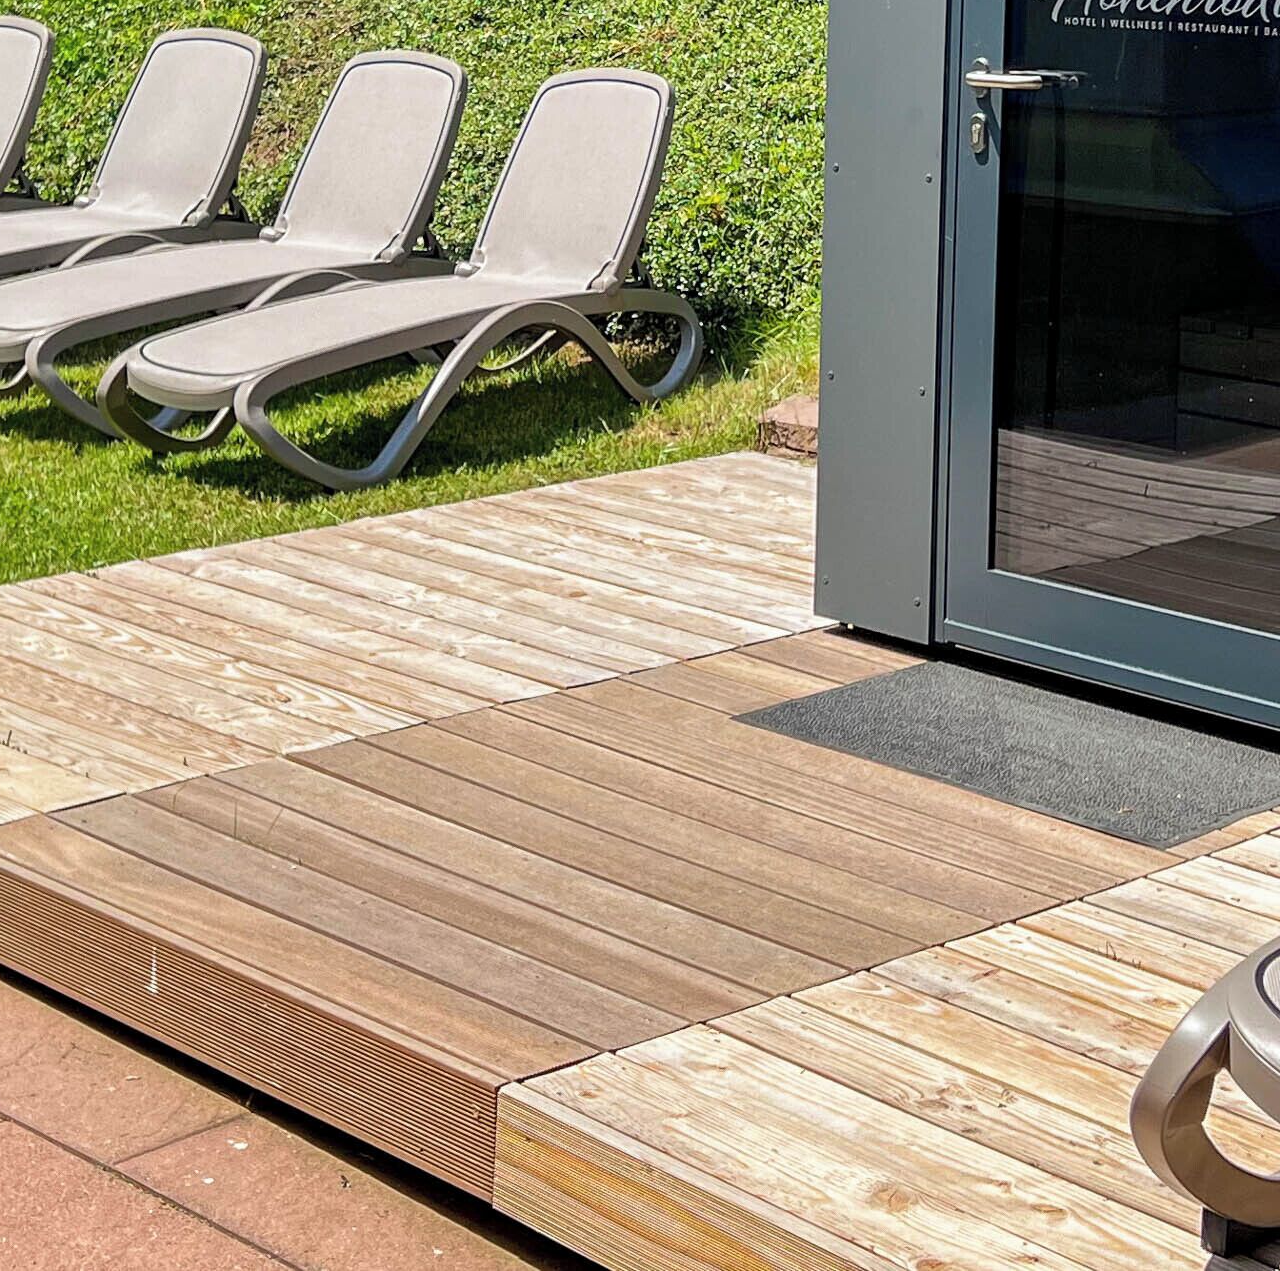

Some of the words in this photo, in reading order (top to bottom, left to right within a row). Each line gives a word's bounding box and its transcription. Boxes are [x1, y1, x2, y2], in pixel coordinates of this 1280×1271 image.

[1064, 17, 1097, 28] HOTEL
[1109, 19, 1164, 31] WELLNESS
[1177, 22, 1250, 35] RESTAURANT
